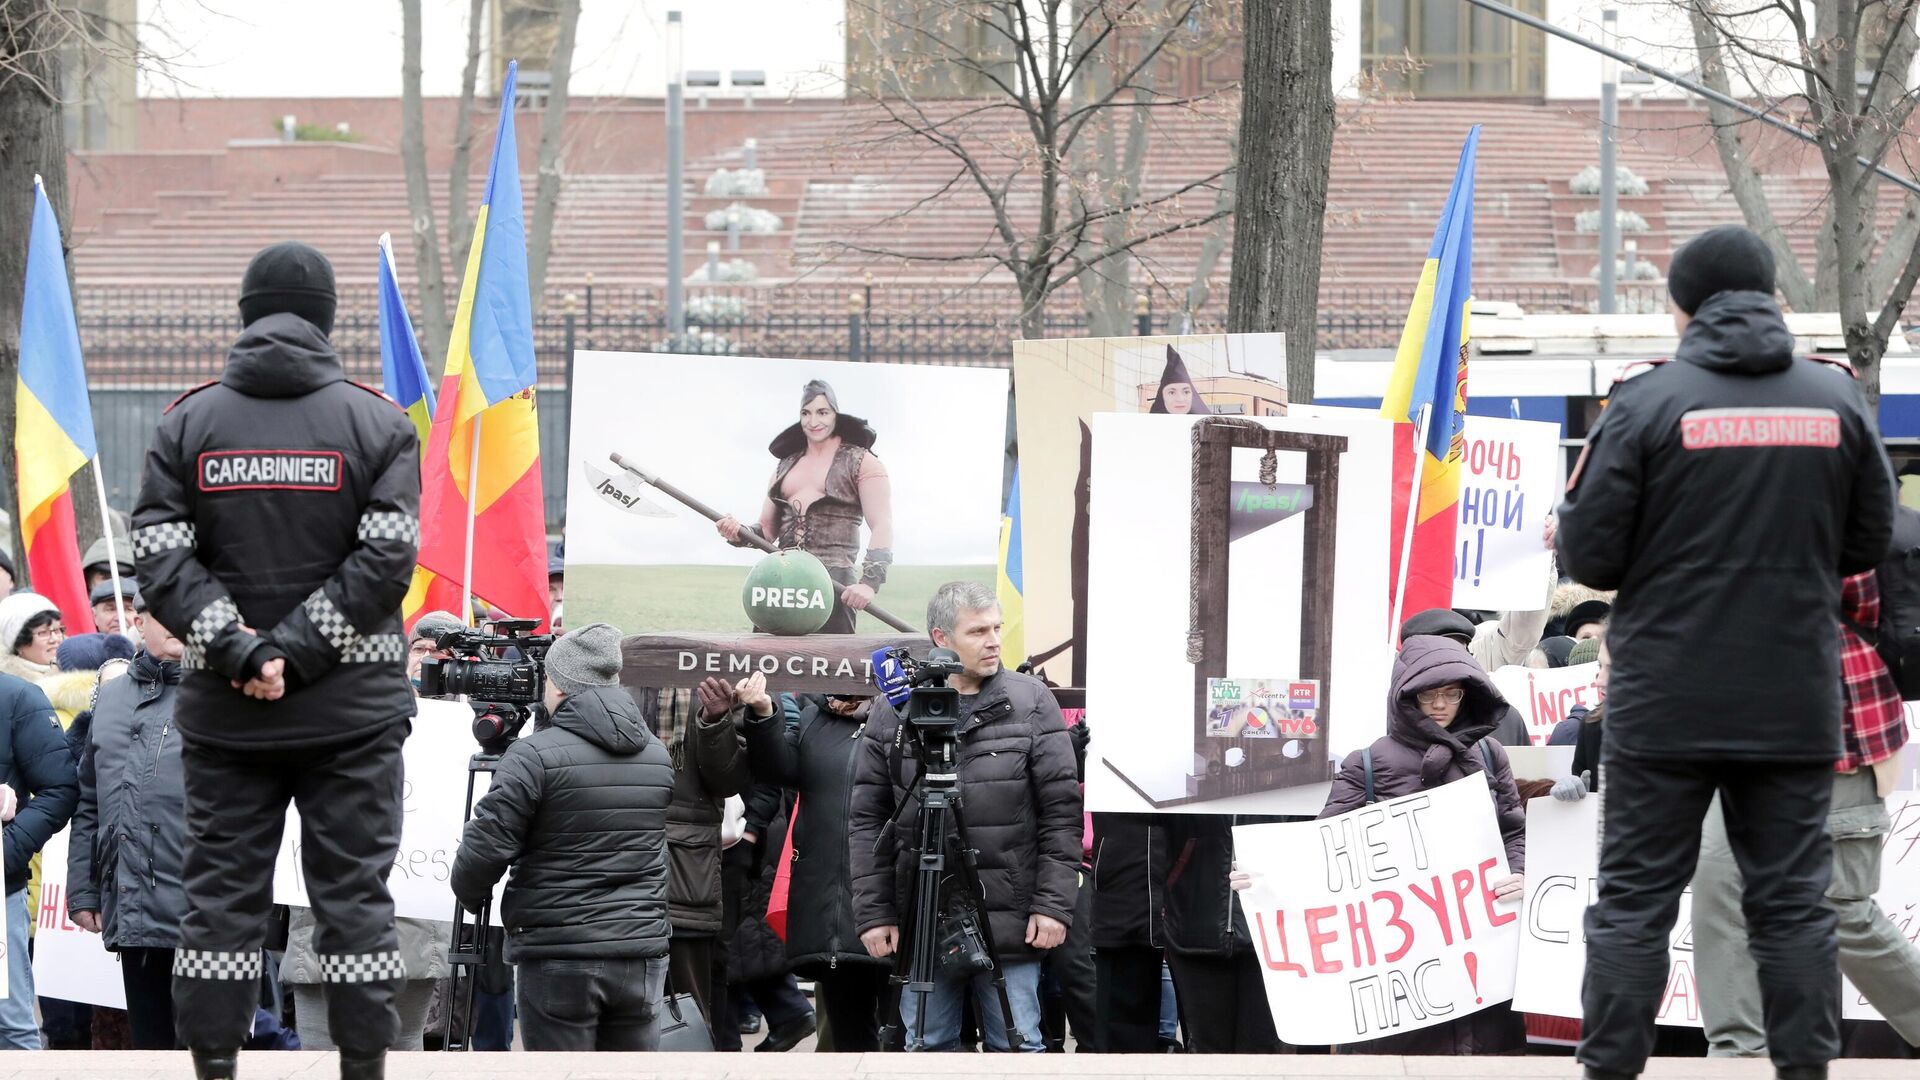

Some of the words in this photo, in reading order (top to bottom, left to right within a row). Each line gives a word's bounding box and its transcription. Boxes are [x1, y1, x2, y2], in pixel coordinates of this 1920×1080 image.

[1683, 419, 1839, 445] CARABINIERI
[205, 456, 336, 484] CARABINIERI
[596, 478, 641, 509] /pas/
[1236, 487, 1303, 513] /pas/
[751, 586, 826, 610] PRESA
[1294, 688, 1311, 696] RTR
[895, 724, 903, 749] SONY
[1278, 716, 1317, 734] TV6
[1320, 795, 1430, 893] НЕТ
[1255, 857, 1517, 978] ЦЕНЗУРЕ
